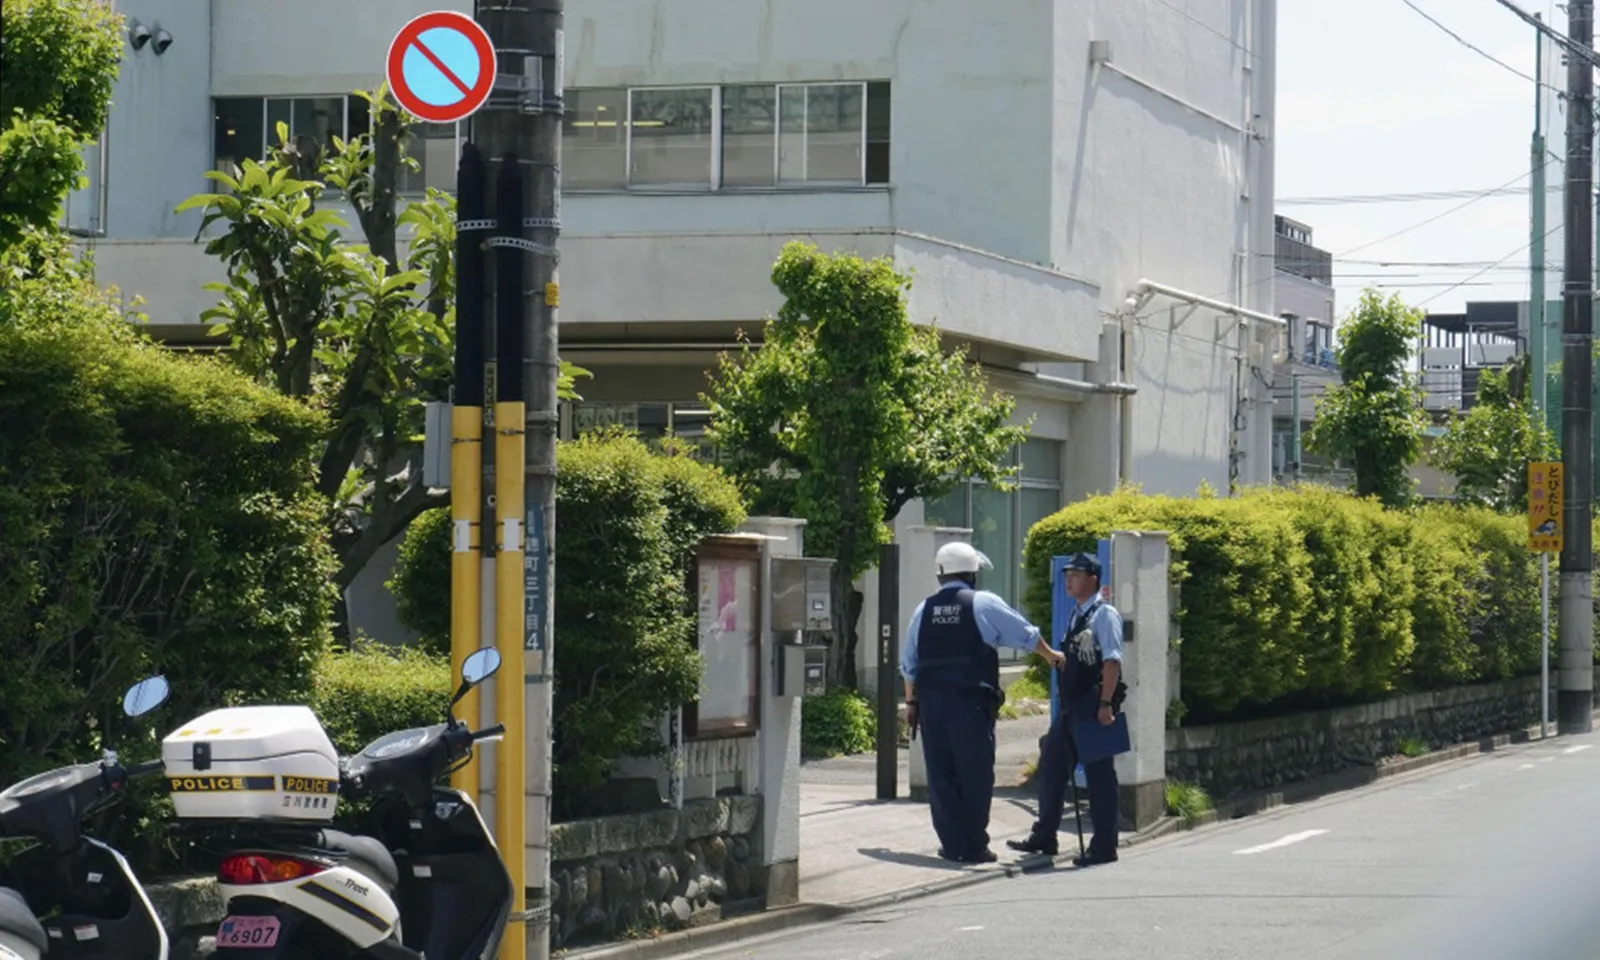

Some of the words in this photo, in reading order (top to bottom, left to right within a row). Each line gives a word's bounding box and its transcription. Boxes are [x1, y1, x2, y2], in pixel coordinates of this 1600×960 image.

[932, 616, 960, 625] POLICE
[171, 778, 245, 790] POLICE
[286, 778, 329, 793] POLICE
[230, 927, 275, 943] 6907
